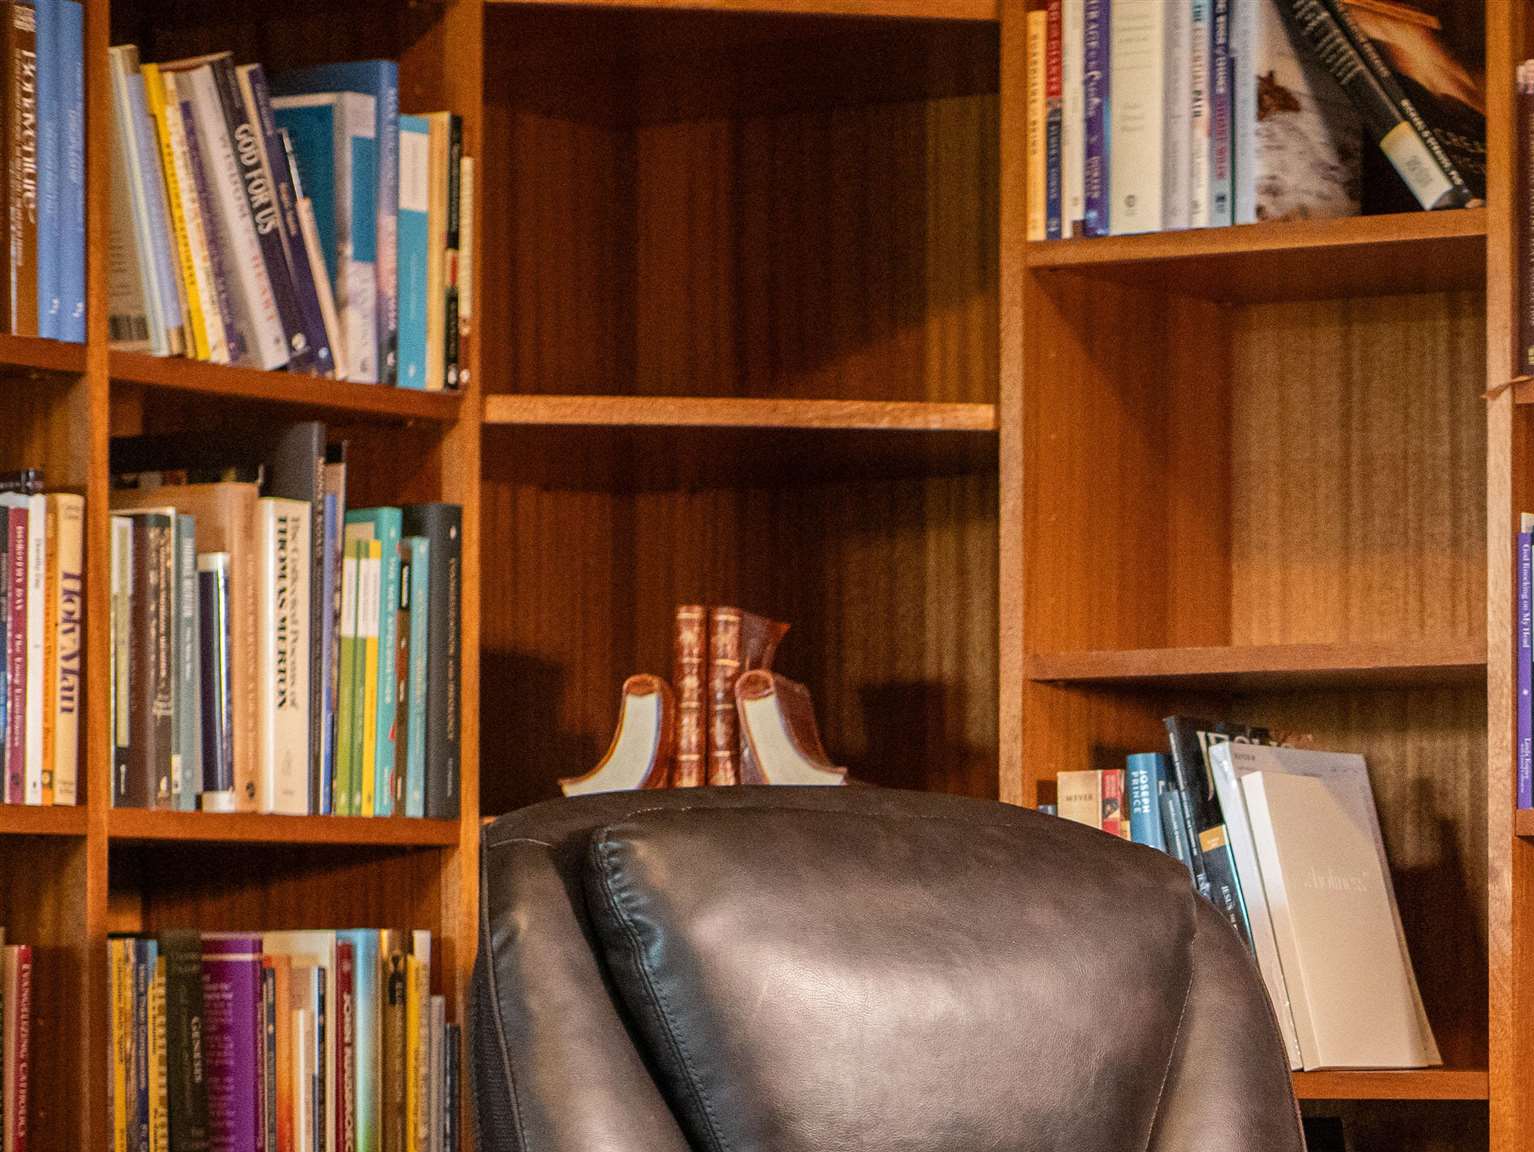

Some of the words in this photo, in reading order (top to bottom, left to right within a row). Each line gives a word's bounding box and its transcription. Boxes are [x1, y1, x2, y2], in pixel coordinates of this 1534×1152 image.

[234, 123, 260, 165] GOD
[244, 169, 269, 206] FOR
[254, 204, 278, 236] US
[277, 516, 288, 609] THOMAS
[1521, 613, 1531, 625] My
[277, 615, 288, 710] MERTON
[1130, 770, 1141, 815] PRINCE
[1139, 769, 1151, 815] JOSEPH
